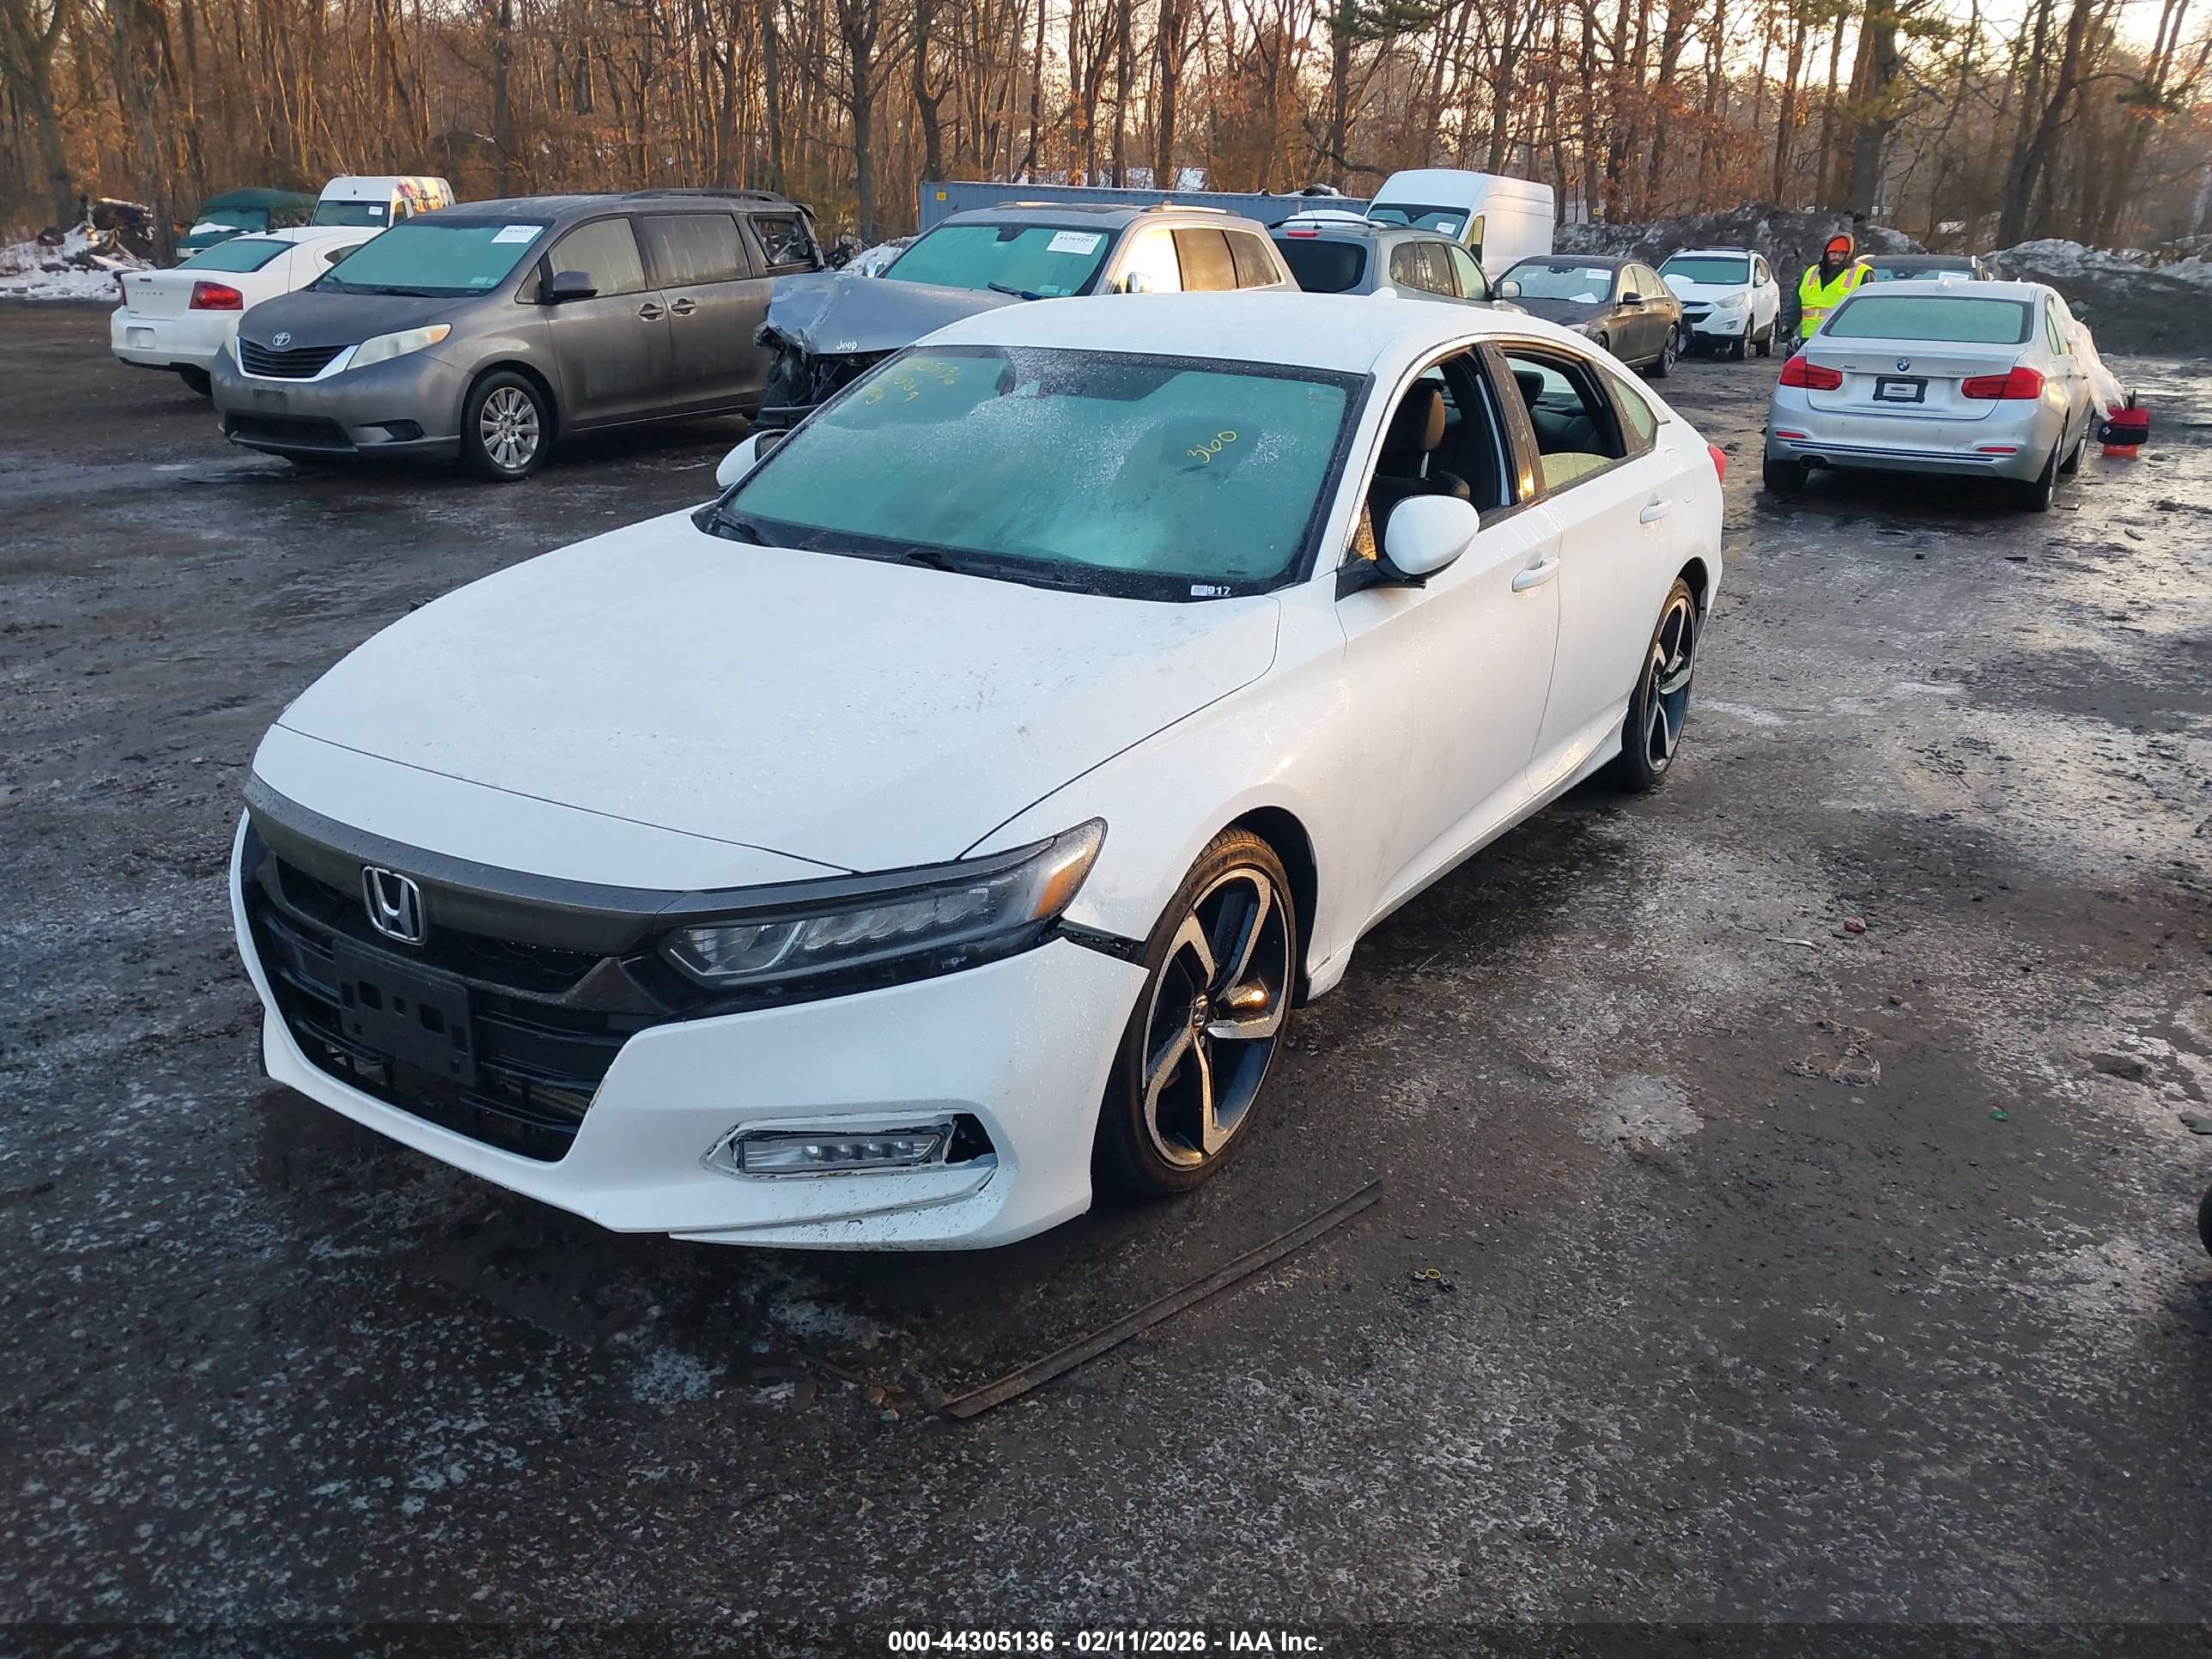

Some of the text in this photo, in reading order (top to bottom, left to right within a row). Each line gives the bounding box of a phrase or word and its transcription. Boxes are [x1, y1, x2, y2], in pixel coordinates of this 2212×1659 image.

[837, 340, 858, 351] Jeep
[1187, 430, 1237, 465] 360
[1207, 586, 1231, 595] 917
